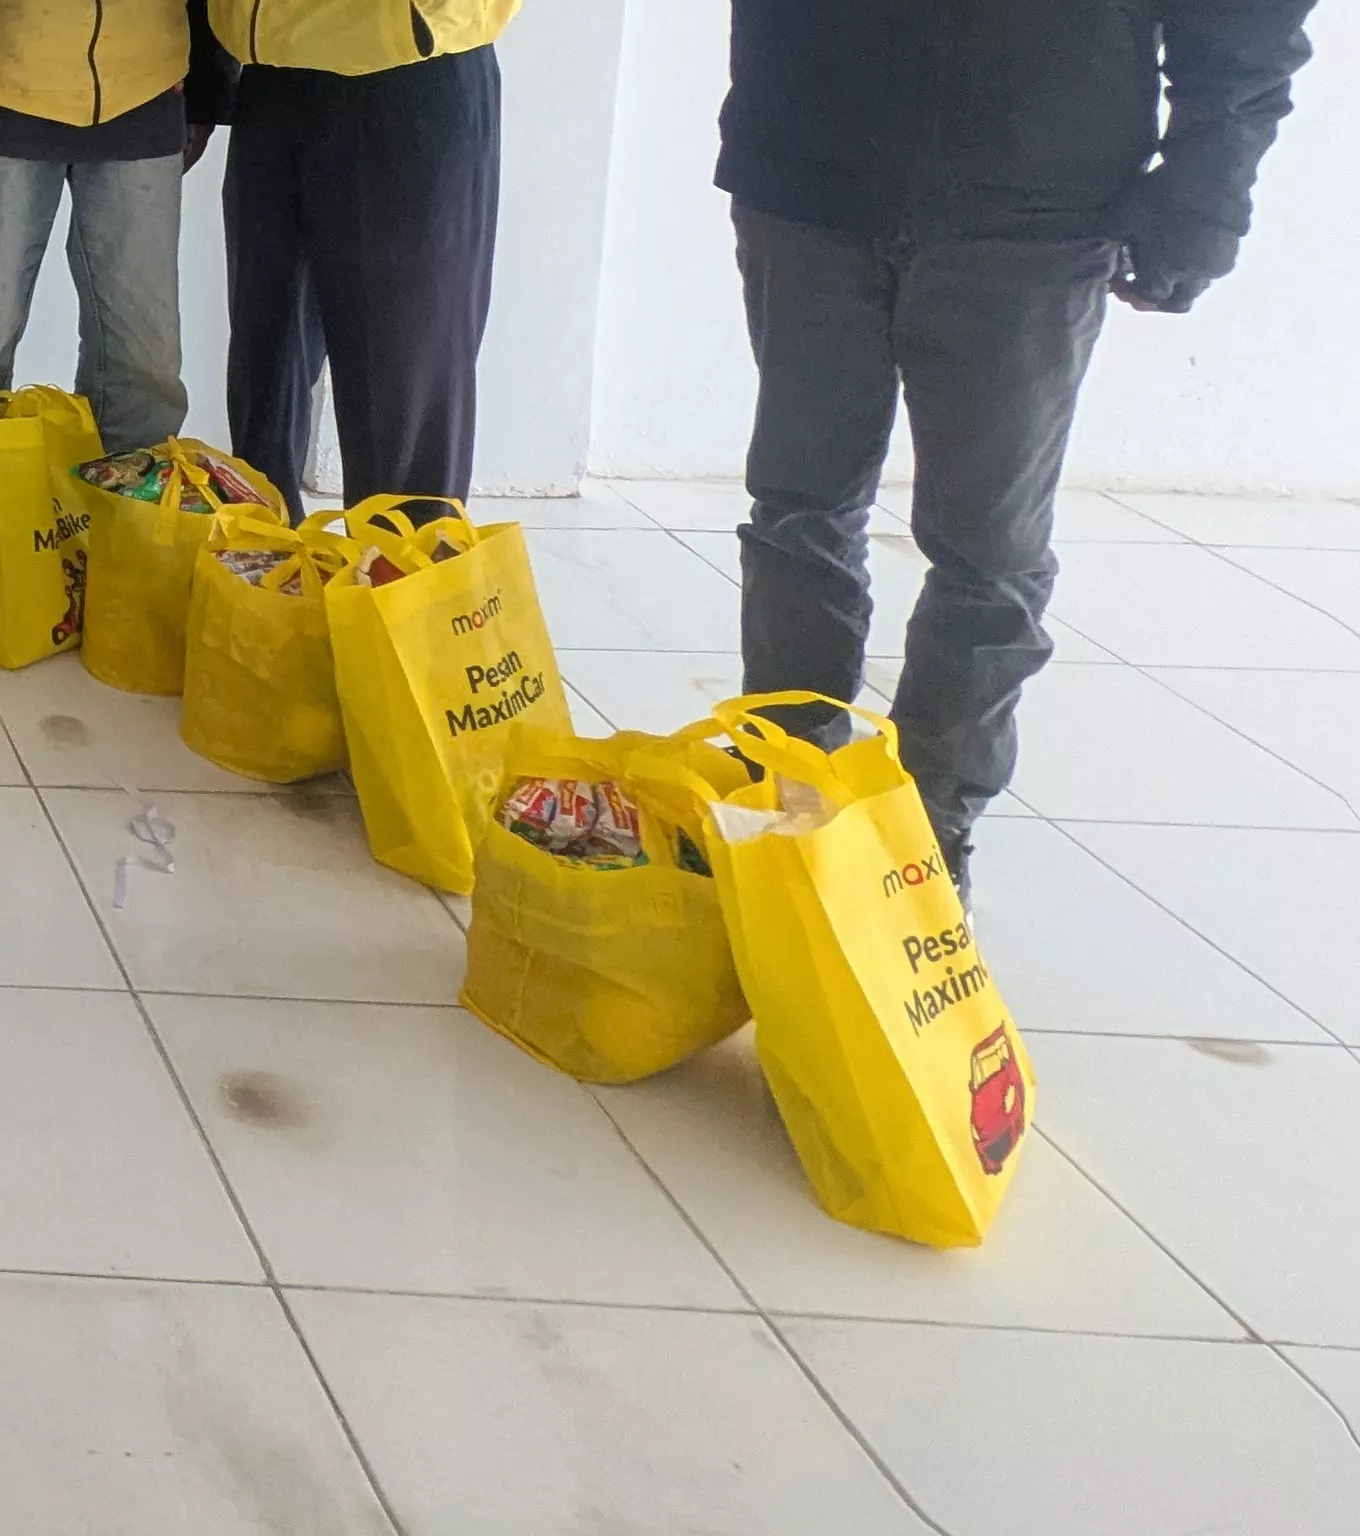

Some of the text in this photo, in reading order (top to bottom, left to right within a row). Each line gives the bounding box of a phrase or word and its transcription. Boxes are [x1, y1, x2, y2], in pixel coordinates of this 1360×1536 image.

[445, 671, 546, 737] MaximCar
[882, 844, 944, 899] maxi
[902, 922, 973, 974] Pesa
[903, 964, 989, 1039] Maxim
